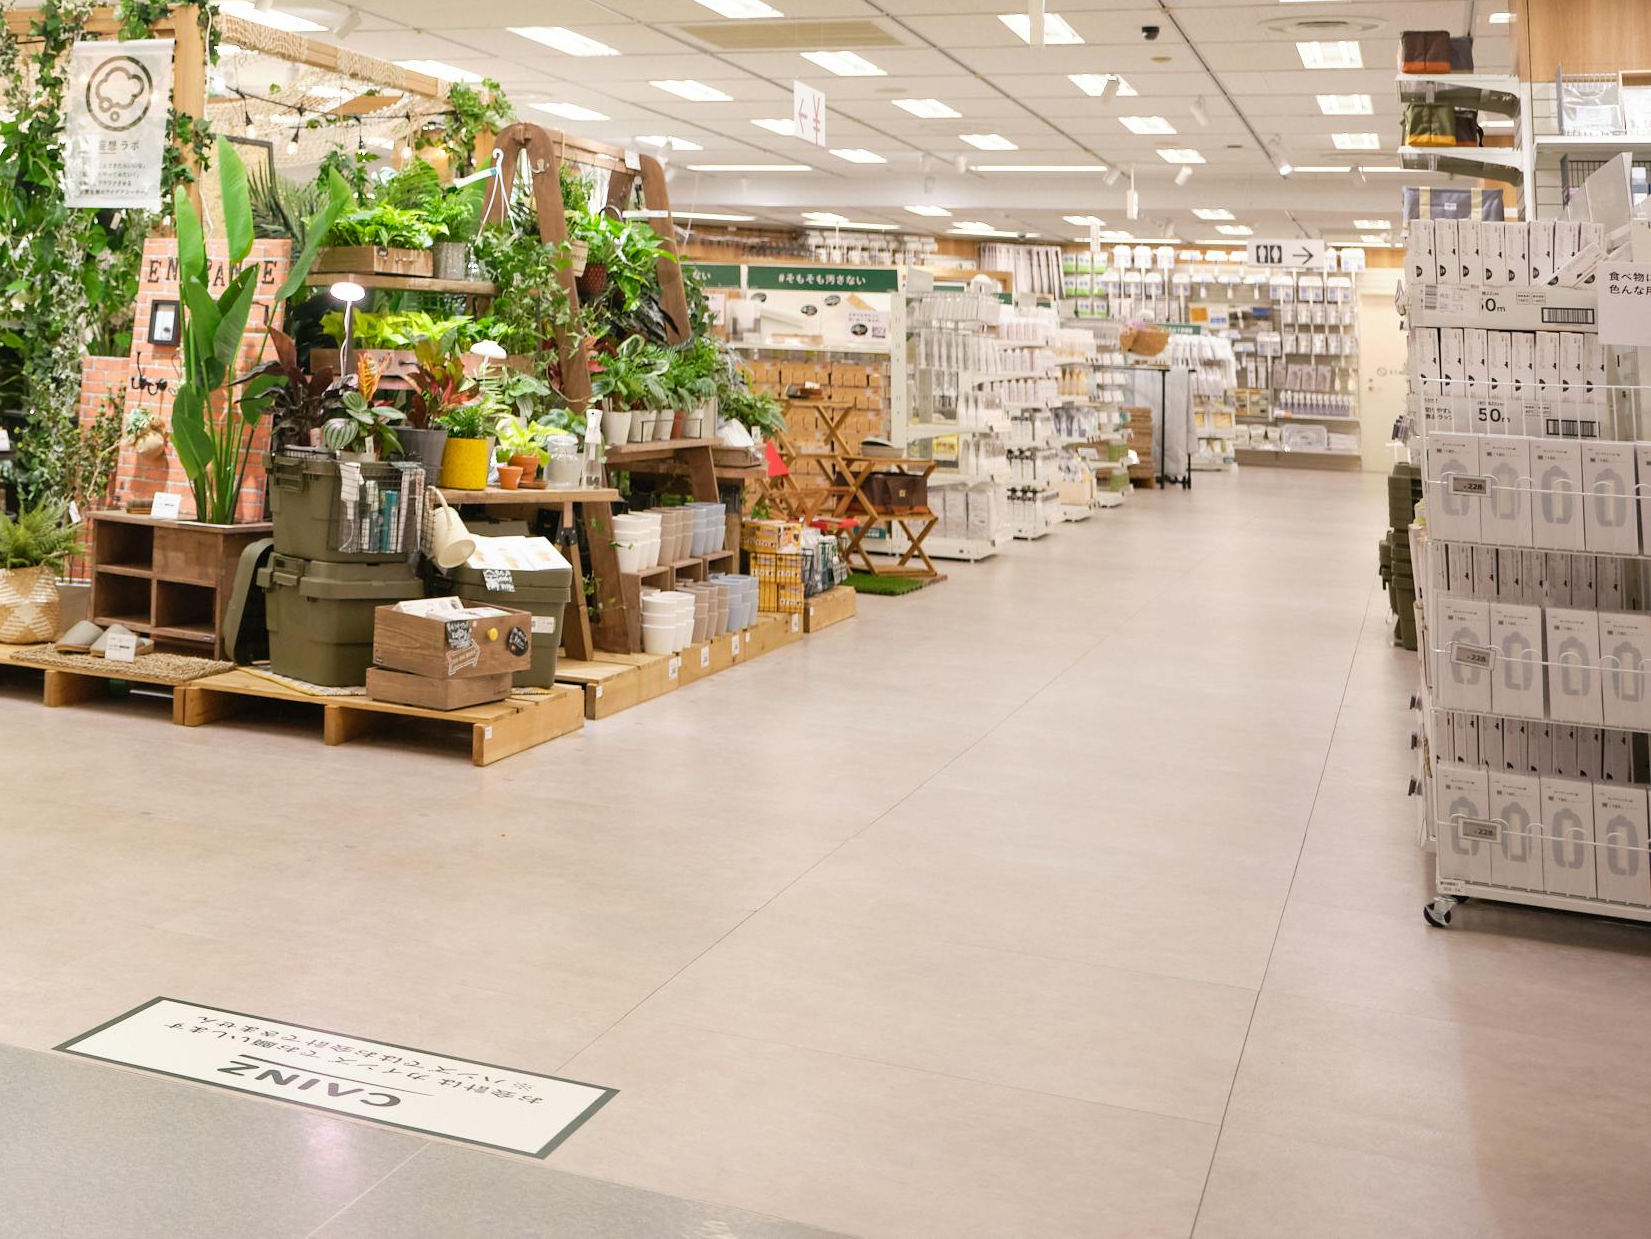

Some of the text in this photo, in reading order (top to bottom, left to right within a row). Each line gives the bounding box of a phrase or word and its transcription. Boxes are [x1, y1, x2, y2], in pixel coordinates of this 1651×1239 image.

[147, 256, 277, 287] ENANE
[1481, 298, 1506, 312] 0m
[216, 1059, 402, 1109] CAINZ
